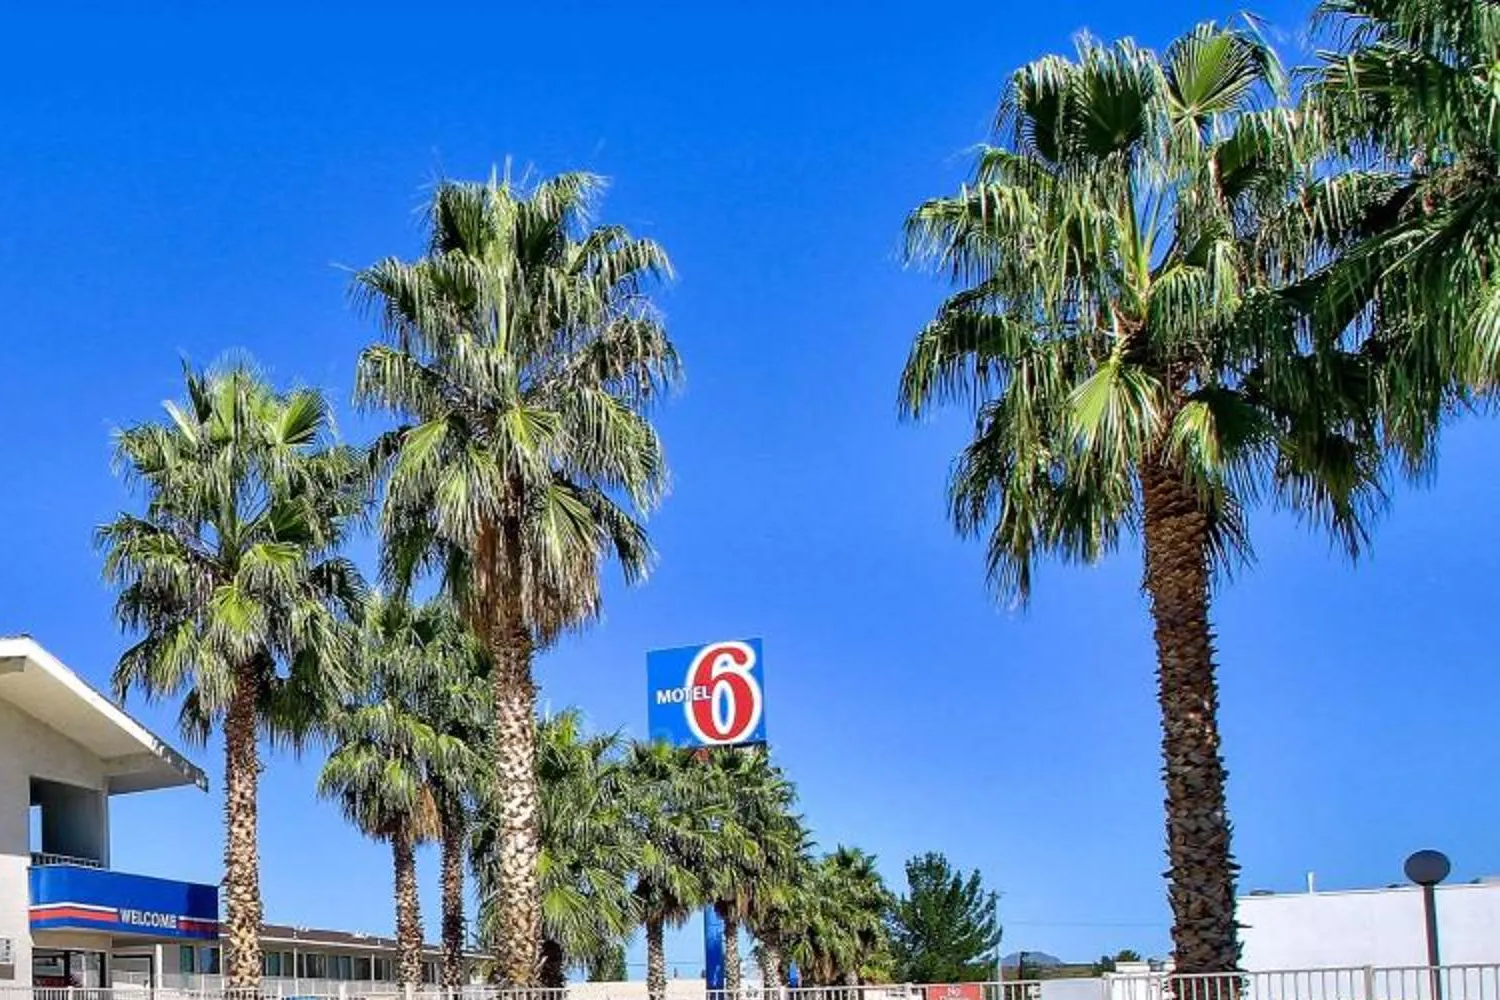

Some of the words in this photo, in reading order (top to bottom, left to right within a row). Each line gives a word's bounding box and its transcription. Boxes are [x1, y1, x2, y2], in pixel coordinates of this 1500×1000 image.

[656, 685, 712, 704] MOTEL
[685, 642, 761, 743] 6
[120, 908, 177, 929] WELCOME
